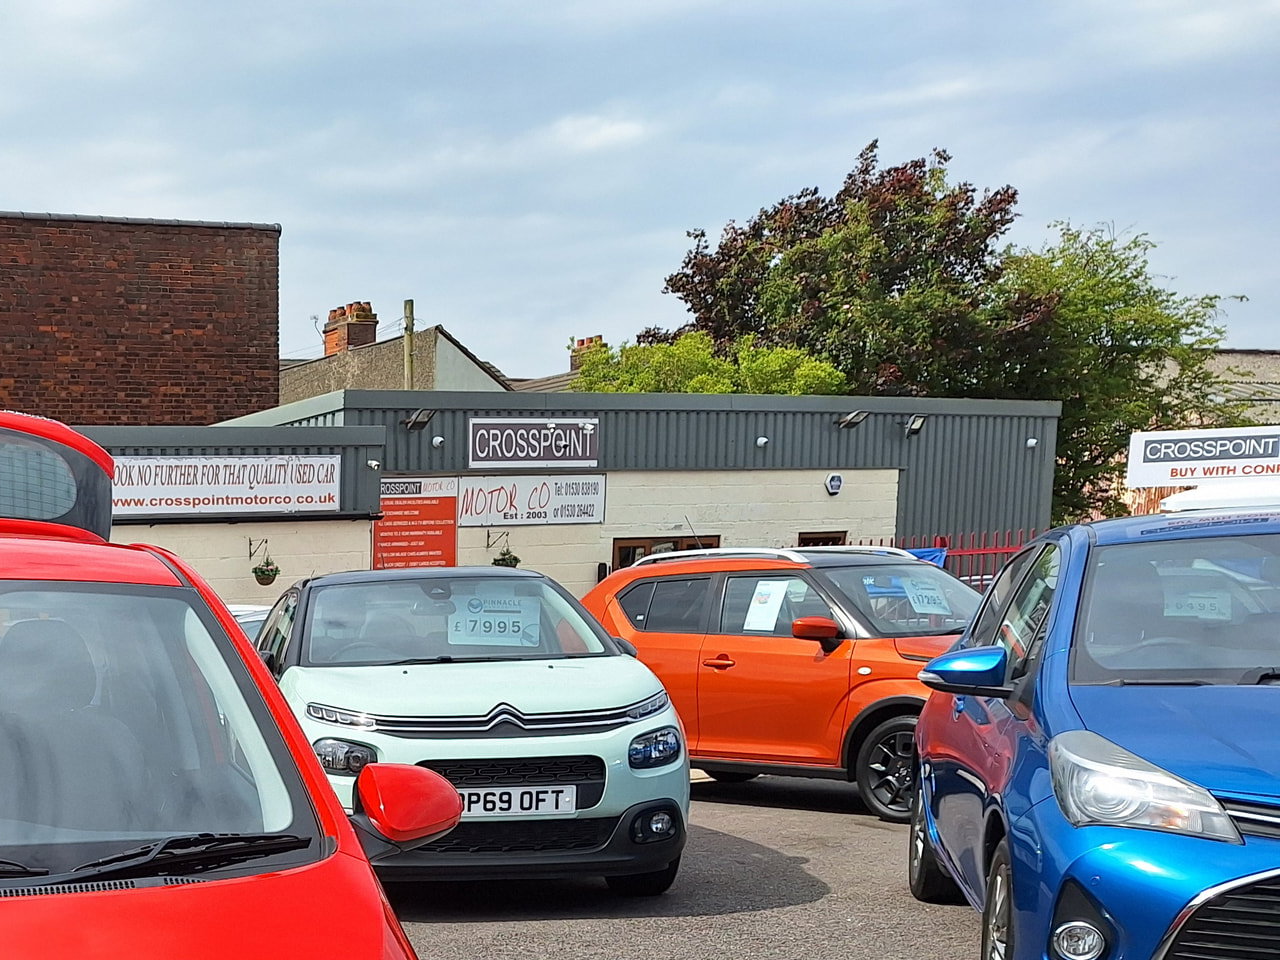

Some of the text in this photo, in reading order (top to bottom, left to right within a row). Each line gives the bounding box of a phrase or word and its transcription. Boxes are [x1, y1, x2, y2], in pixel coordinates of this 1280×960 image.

[476, 429, 594, 457] CROSSPOINT
[1146, 438, 1278, 459] CROSSPOINT
[113, 463, 335, 490] OOK NO FURTHER FOR THAT QUALITY USED CAR
[1170, 467, 1197, 477] BUY
[1203, 465, 1236, 476] WITH
[381, 483, 420, 494] ROSSPOINT
[460, 482, 551, 520] MOTOR CO
[503, 512, 518, 520] Est
[526, 511, 548, 519] 2003
[520, 790, 564, 811] OFT
